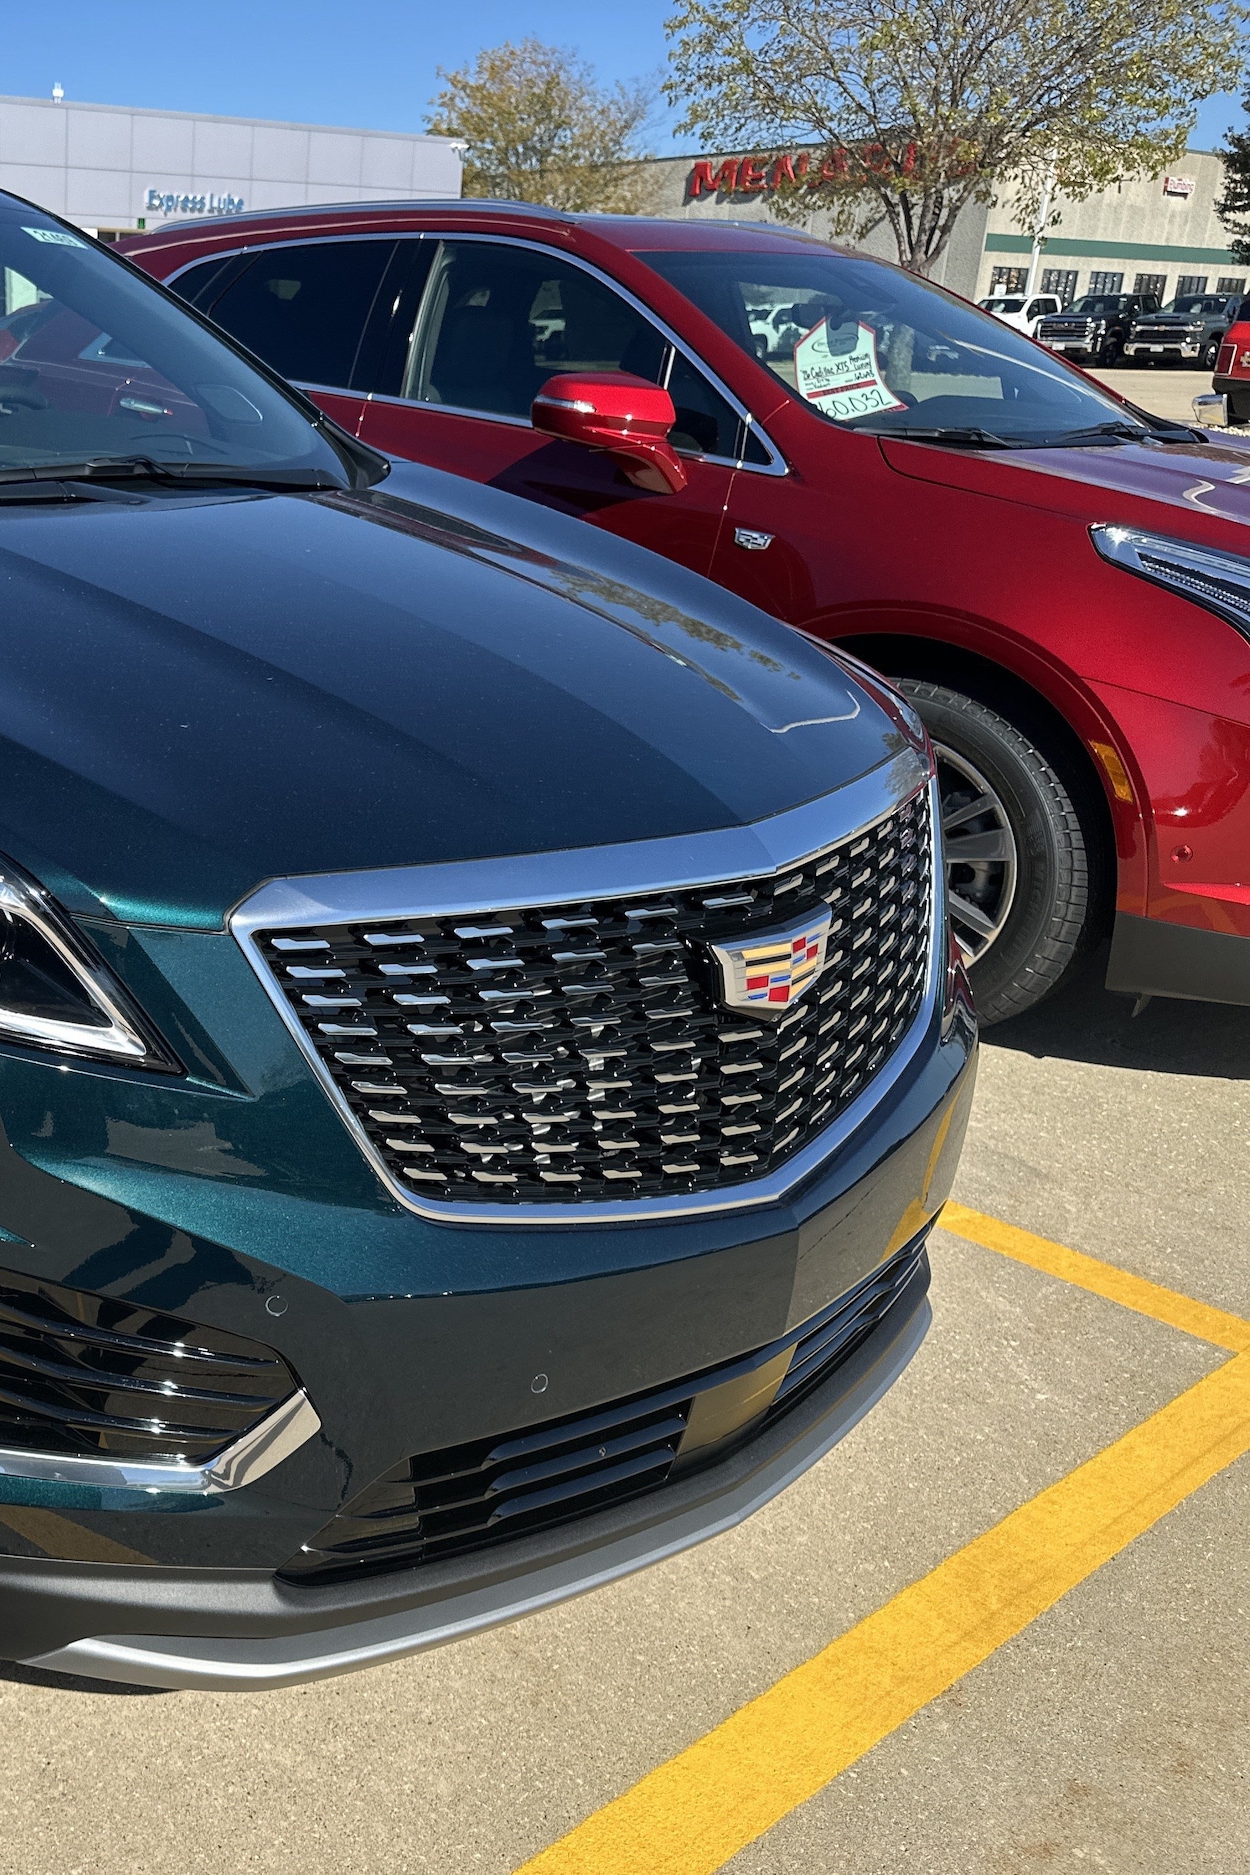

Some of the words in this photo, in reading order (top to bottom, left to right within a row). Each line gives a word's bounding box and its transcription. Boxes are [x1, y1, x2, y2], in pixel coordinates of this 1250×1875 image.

[146, 188, 206, 214] Express
[209, 193, 245, 211] Lube
[834, 360, 850, 373] XT5
